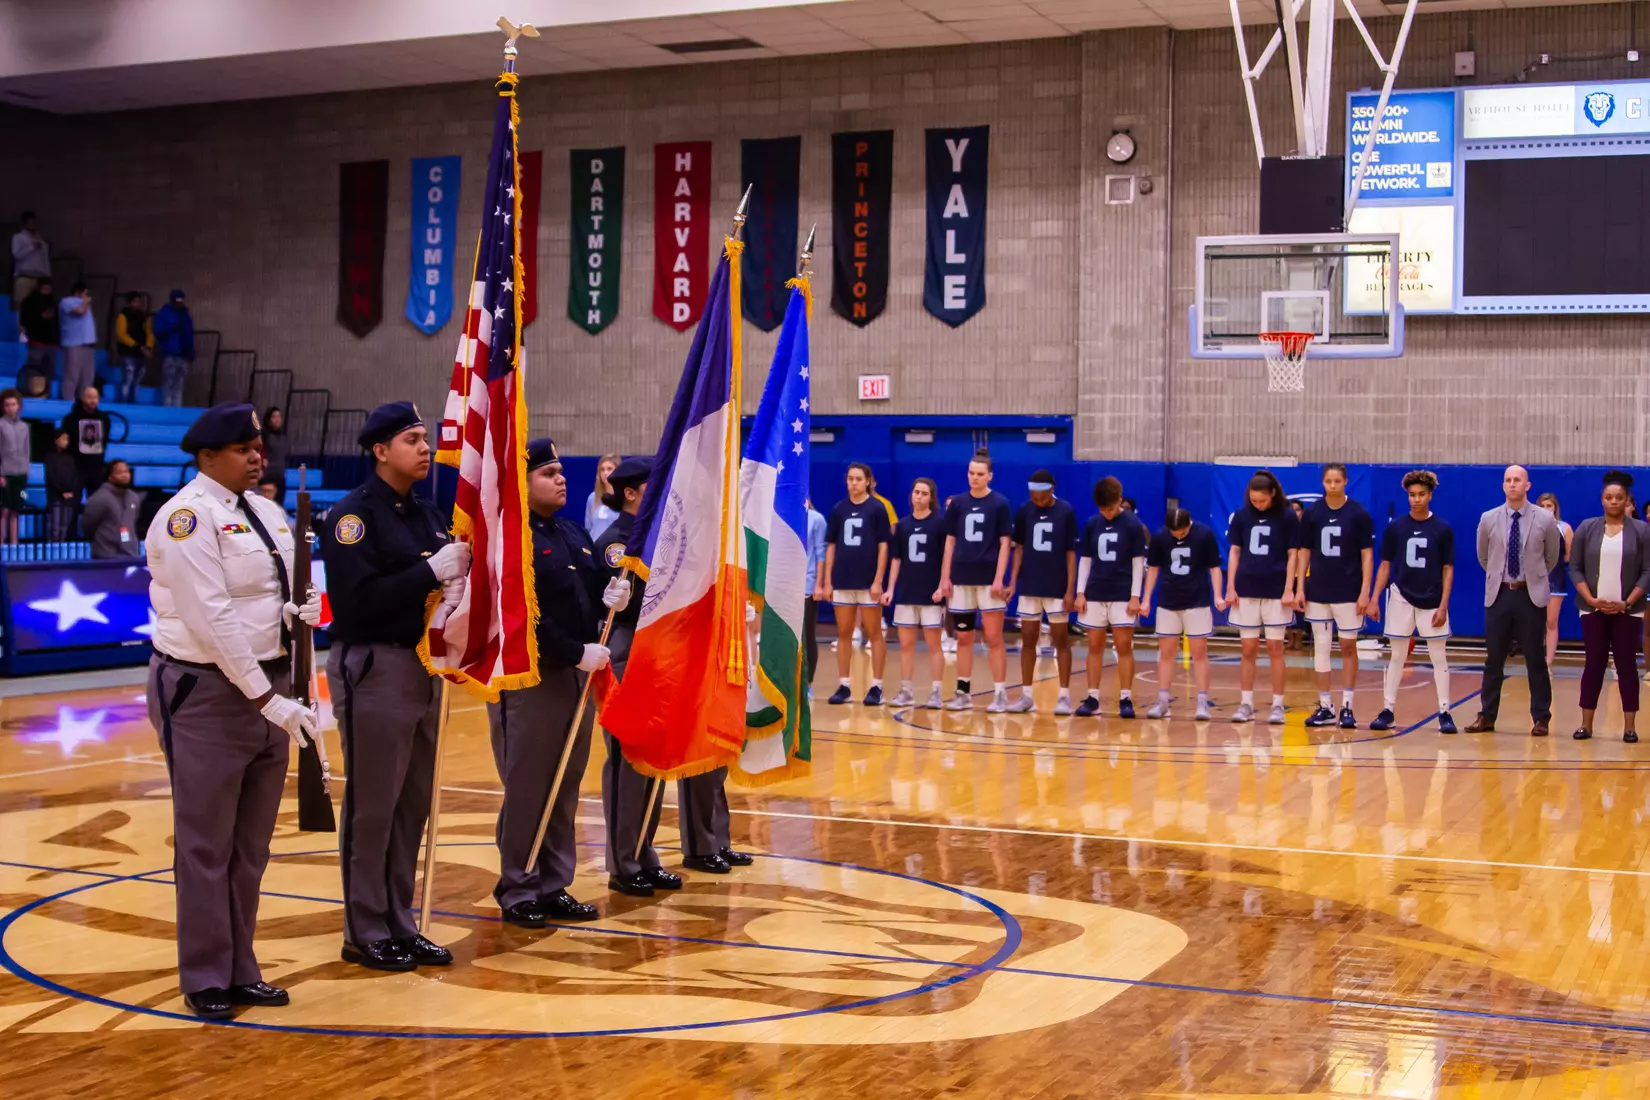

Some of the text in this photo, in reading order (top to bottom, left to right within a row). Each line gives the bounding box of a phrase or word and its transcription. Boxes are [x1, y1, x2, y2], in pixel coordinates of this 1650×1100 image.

[1352, 105, 1409, 118] 35000+
[673, 152, 692, 323] HARVARD
[853, 141, 869, 318] PRINCETON
[943, 139, 970, 310] YALE
[424, 166, 442, 326] COLUMBIA
[587, 159, 604, 325] DARTMOUTH
[1366, 251, 1434, 263] LIBRTY
[862, 379, 885, 397] EXIT
[843, 518, 863, 546] C
[965, 513, 985, 542] C
[1032, 522, 1053, 551] C
[1249, 526, 1271, 555] C
[1320, 526, 1342, 556] C
[908, 534, 927, 562] C
[1098, 533, 1118, 561] C
[1170, 547, 1191, 575] C
[1406, 537, 1428, 568] C
